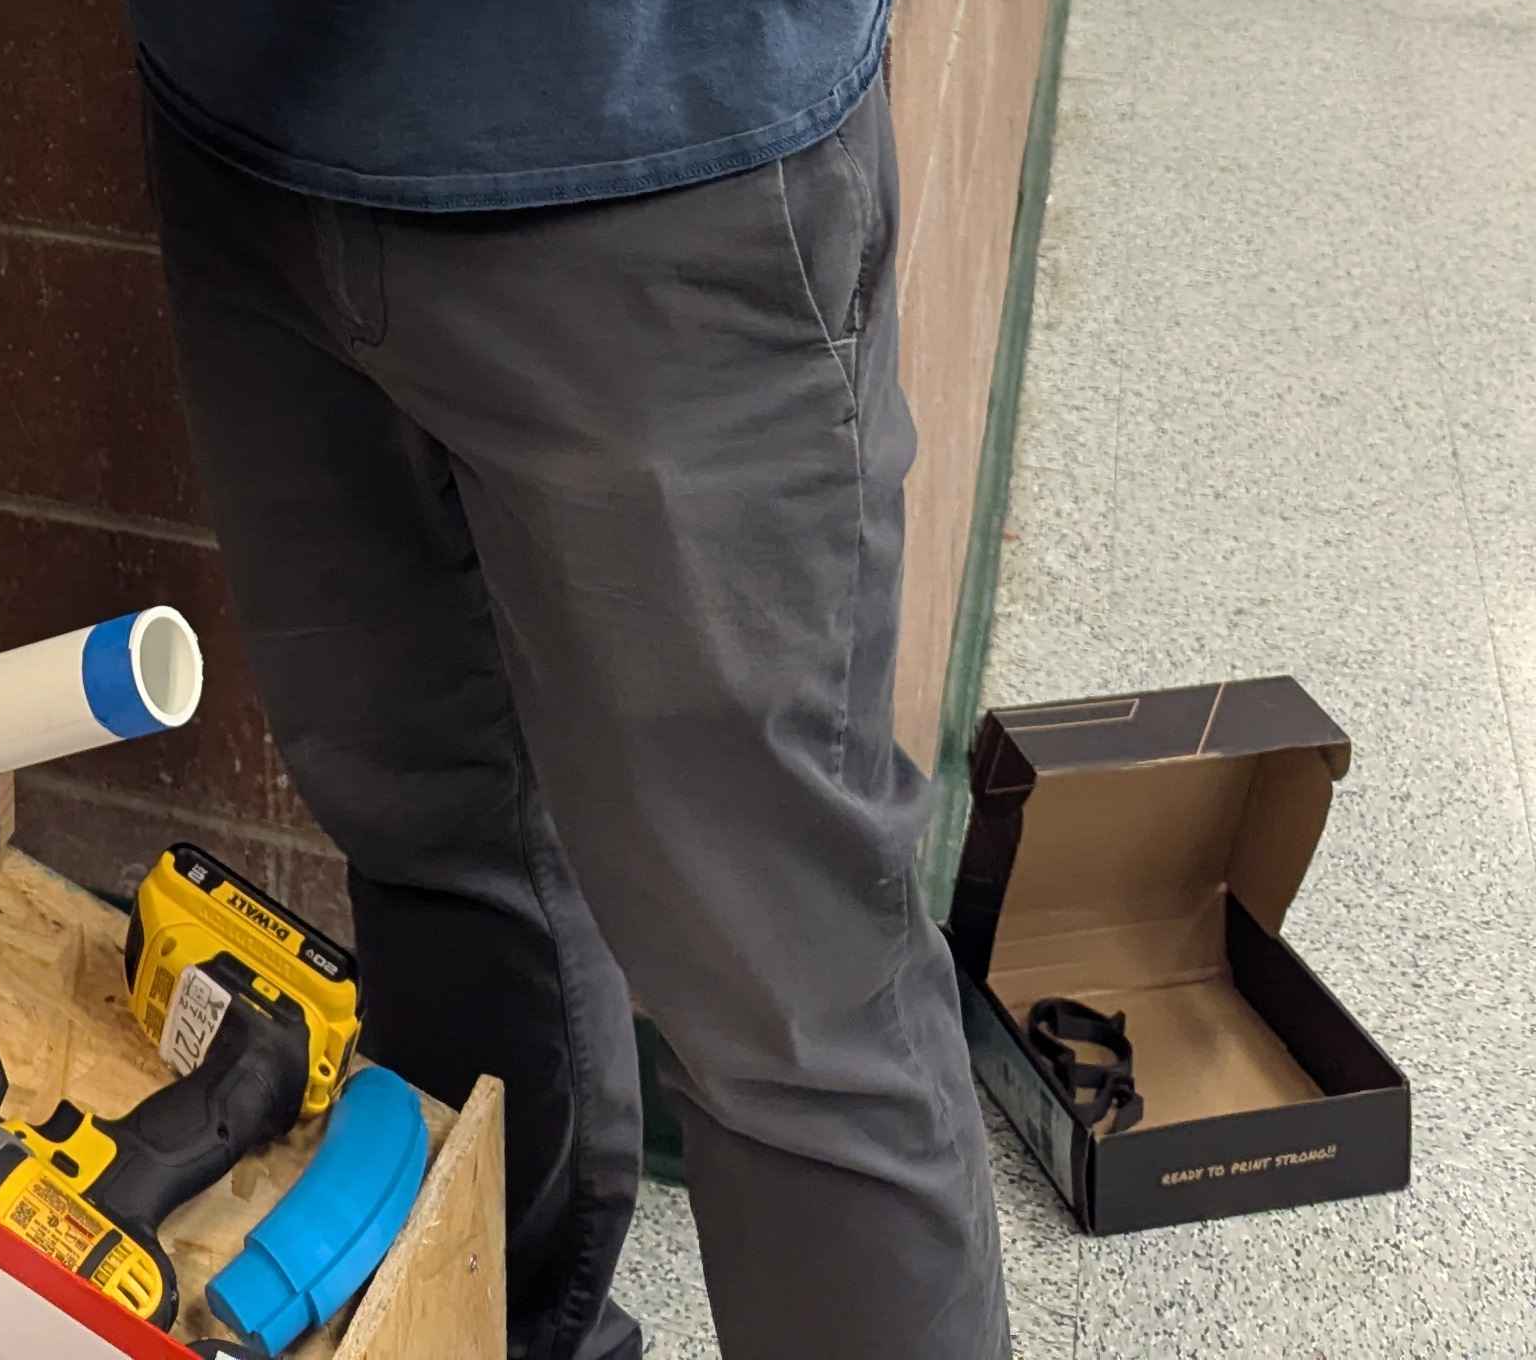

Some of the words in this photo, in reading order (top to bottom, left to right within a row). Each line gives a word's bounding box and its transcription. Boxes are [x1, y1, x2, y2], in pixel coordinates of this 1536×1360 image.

[1160, 1166, 1204, 1186] READY
[1207, 1164, 1226, 1178] TO
[1230, 1156, 1273, 1176] PRINT
